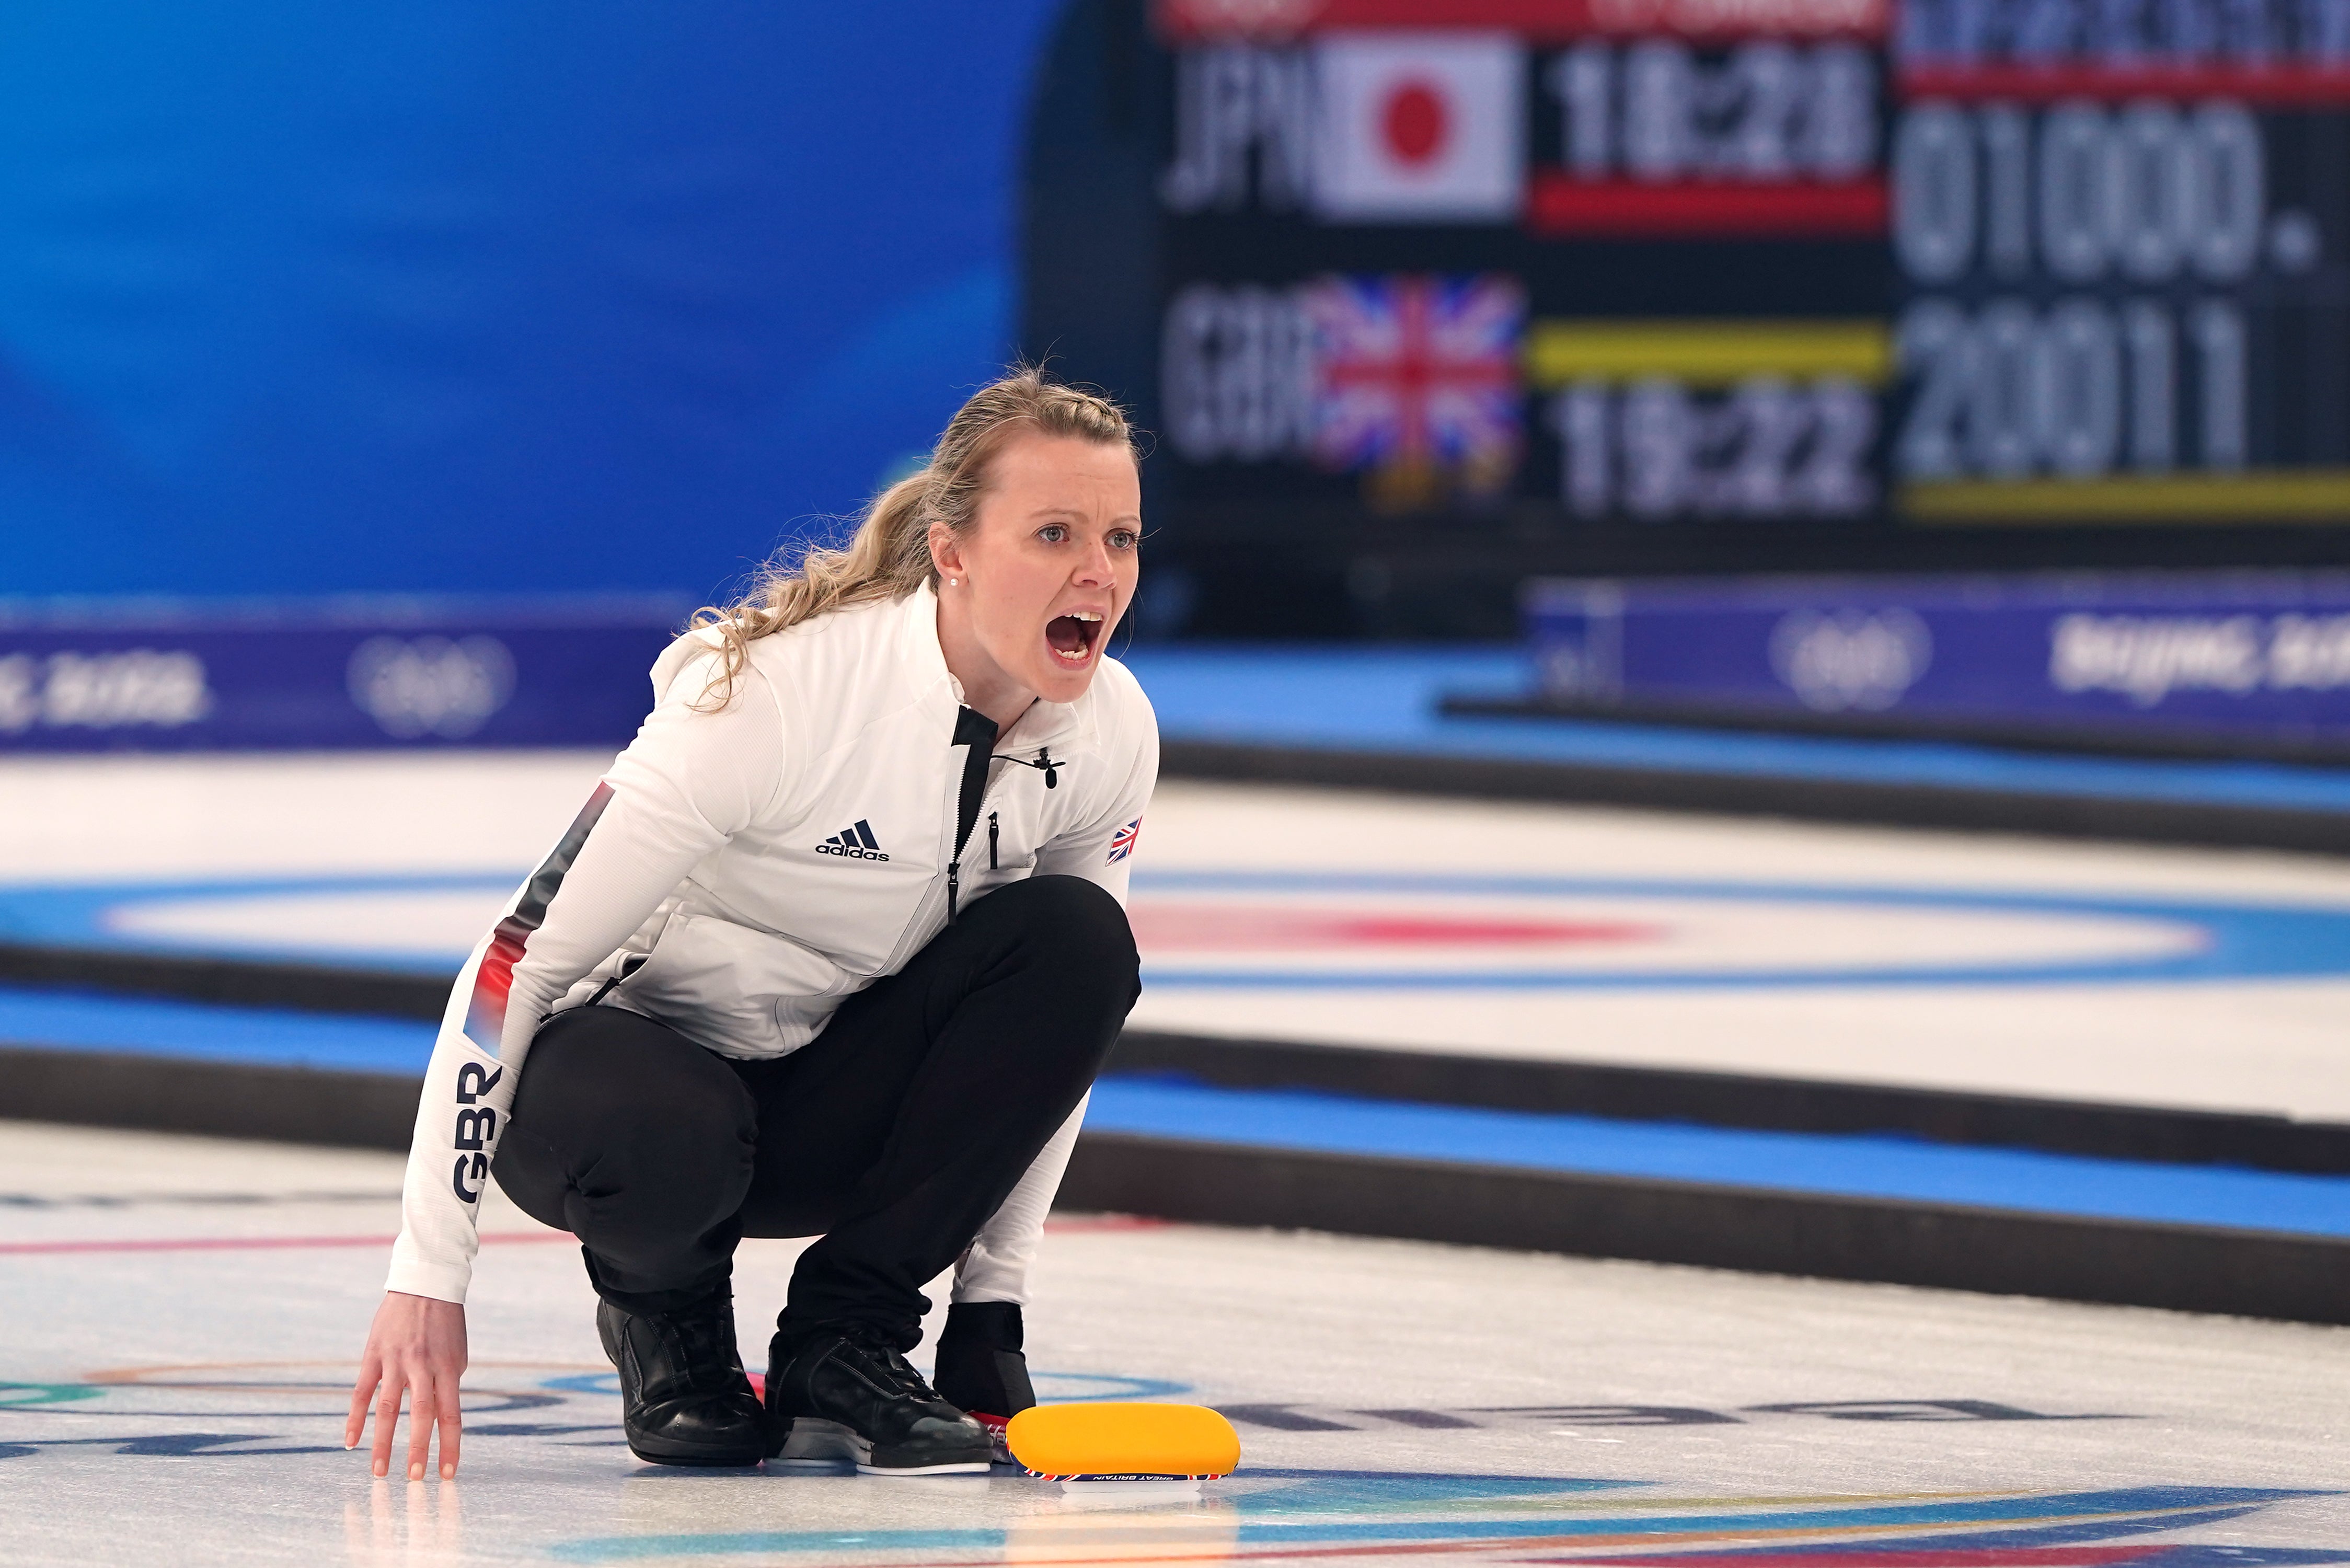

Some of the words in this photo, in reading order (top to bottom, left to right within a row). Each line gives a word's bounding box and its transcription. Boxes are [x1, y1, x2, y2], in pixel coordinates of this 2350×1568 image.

[1895, 299, 2247, 477] 20011
[815, 844, 890, 862] adidas
[453, 1062, 503, 1204] GBR
